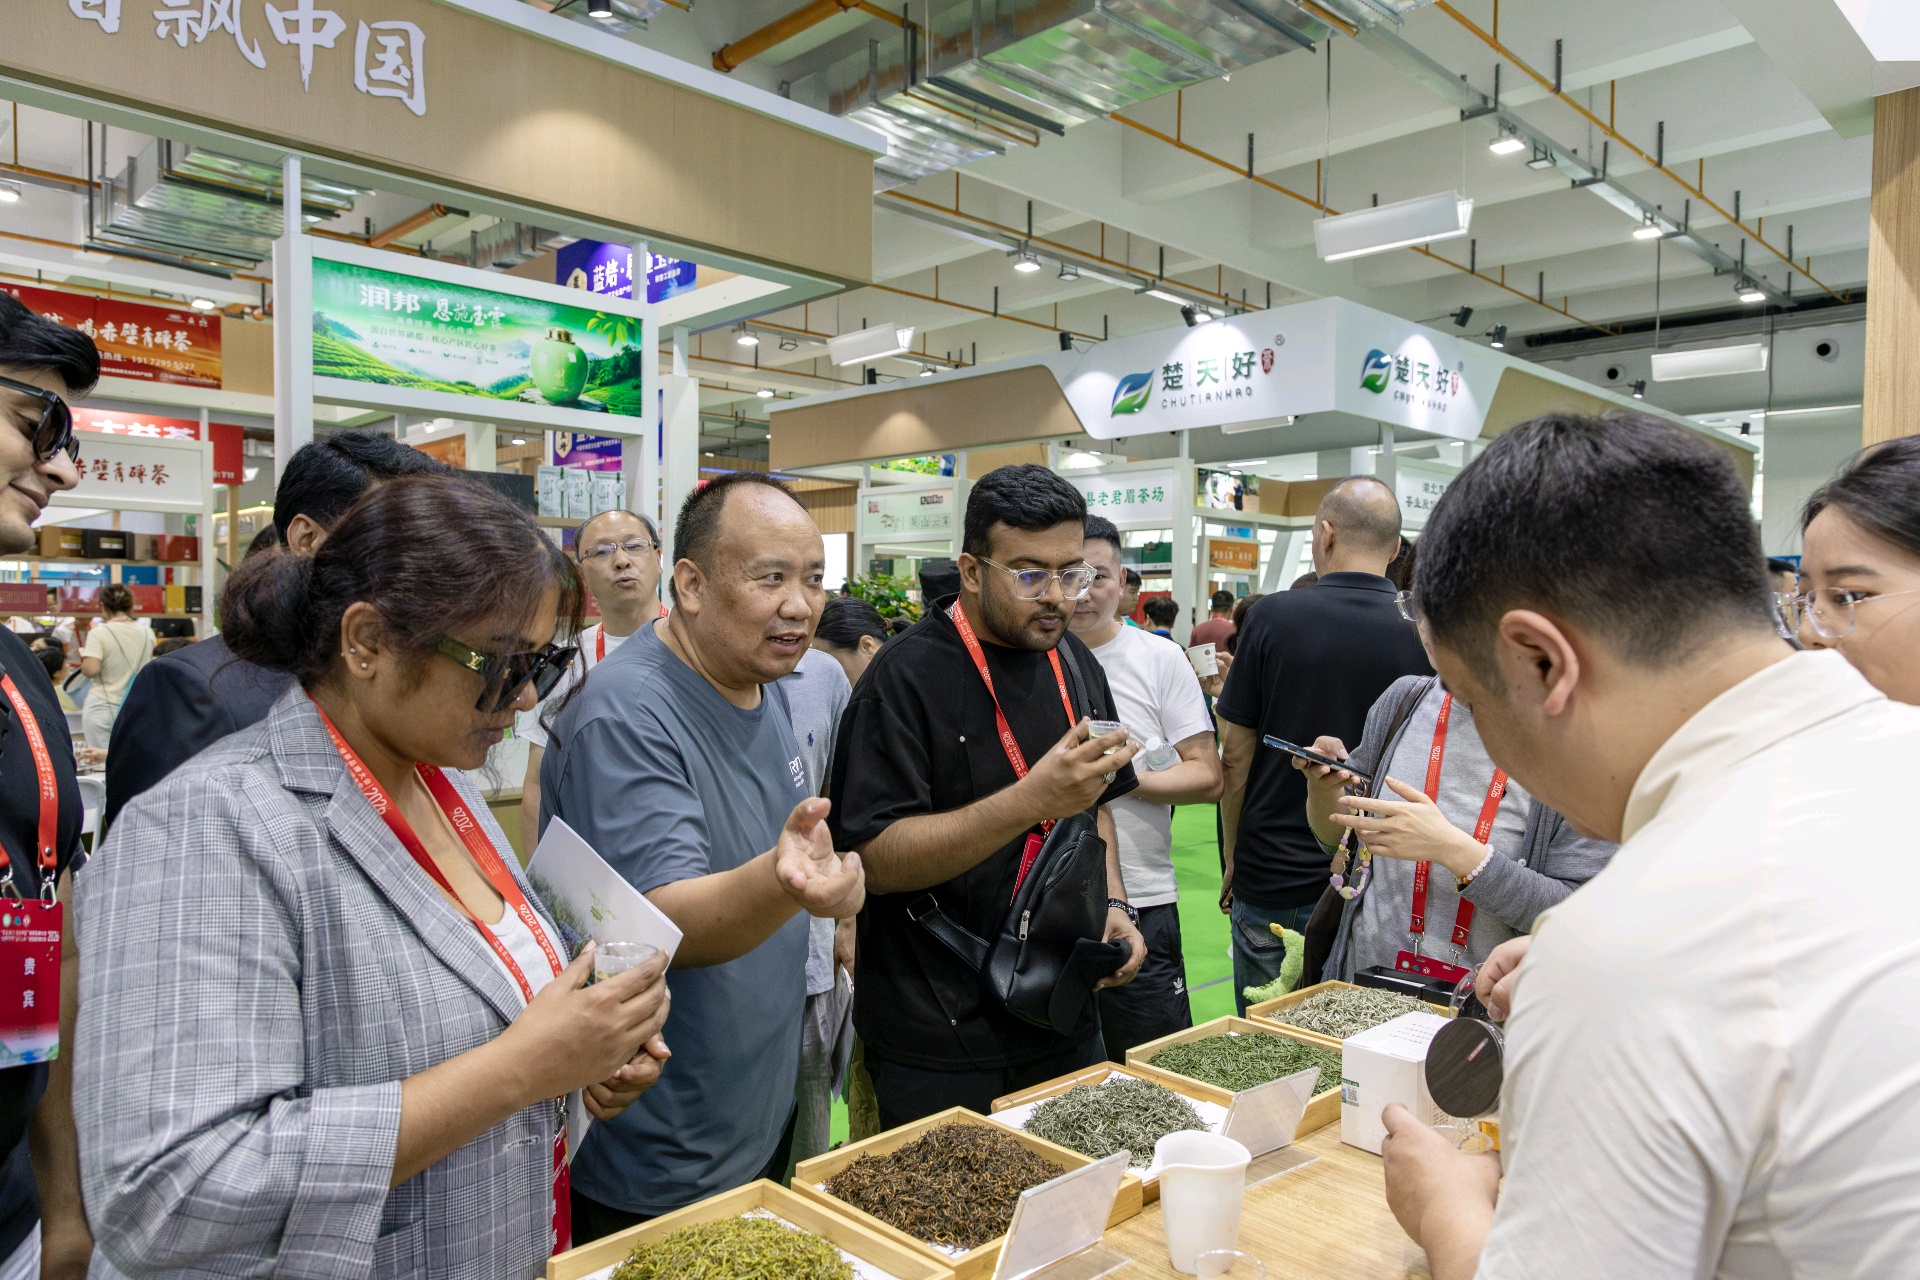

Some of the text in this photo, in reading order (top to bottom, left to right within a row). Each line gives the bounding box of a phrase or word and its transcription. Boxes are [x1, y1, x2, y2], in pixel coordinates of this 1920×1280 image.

[360, 283, 420, 314] 润邦
[1162, 350, 1258, 392] 楚天好
[1394, 355, 1449, 395] 楚天好
[1161, 386, 1254, 409] CHUTIANHAO
[1431, 745, 1441, 761] 2026
[364, 787, 387, 816] 2026
[1489, 780, 1504, 799] 2026
[452, 806, 474, 833] 2026
[520, 903, 537, 927] 2026
[23, 956, 36, 1008] 贵宾
